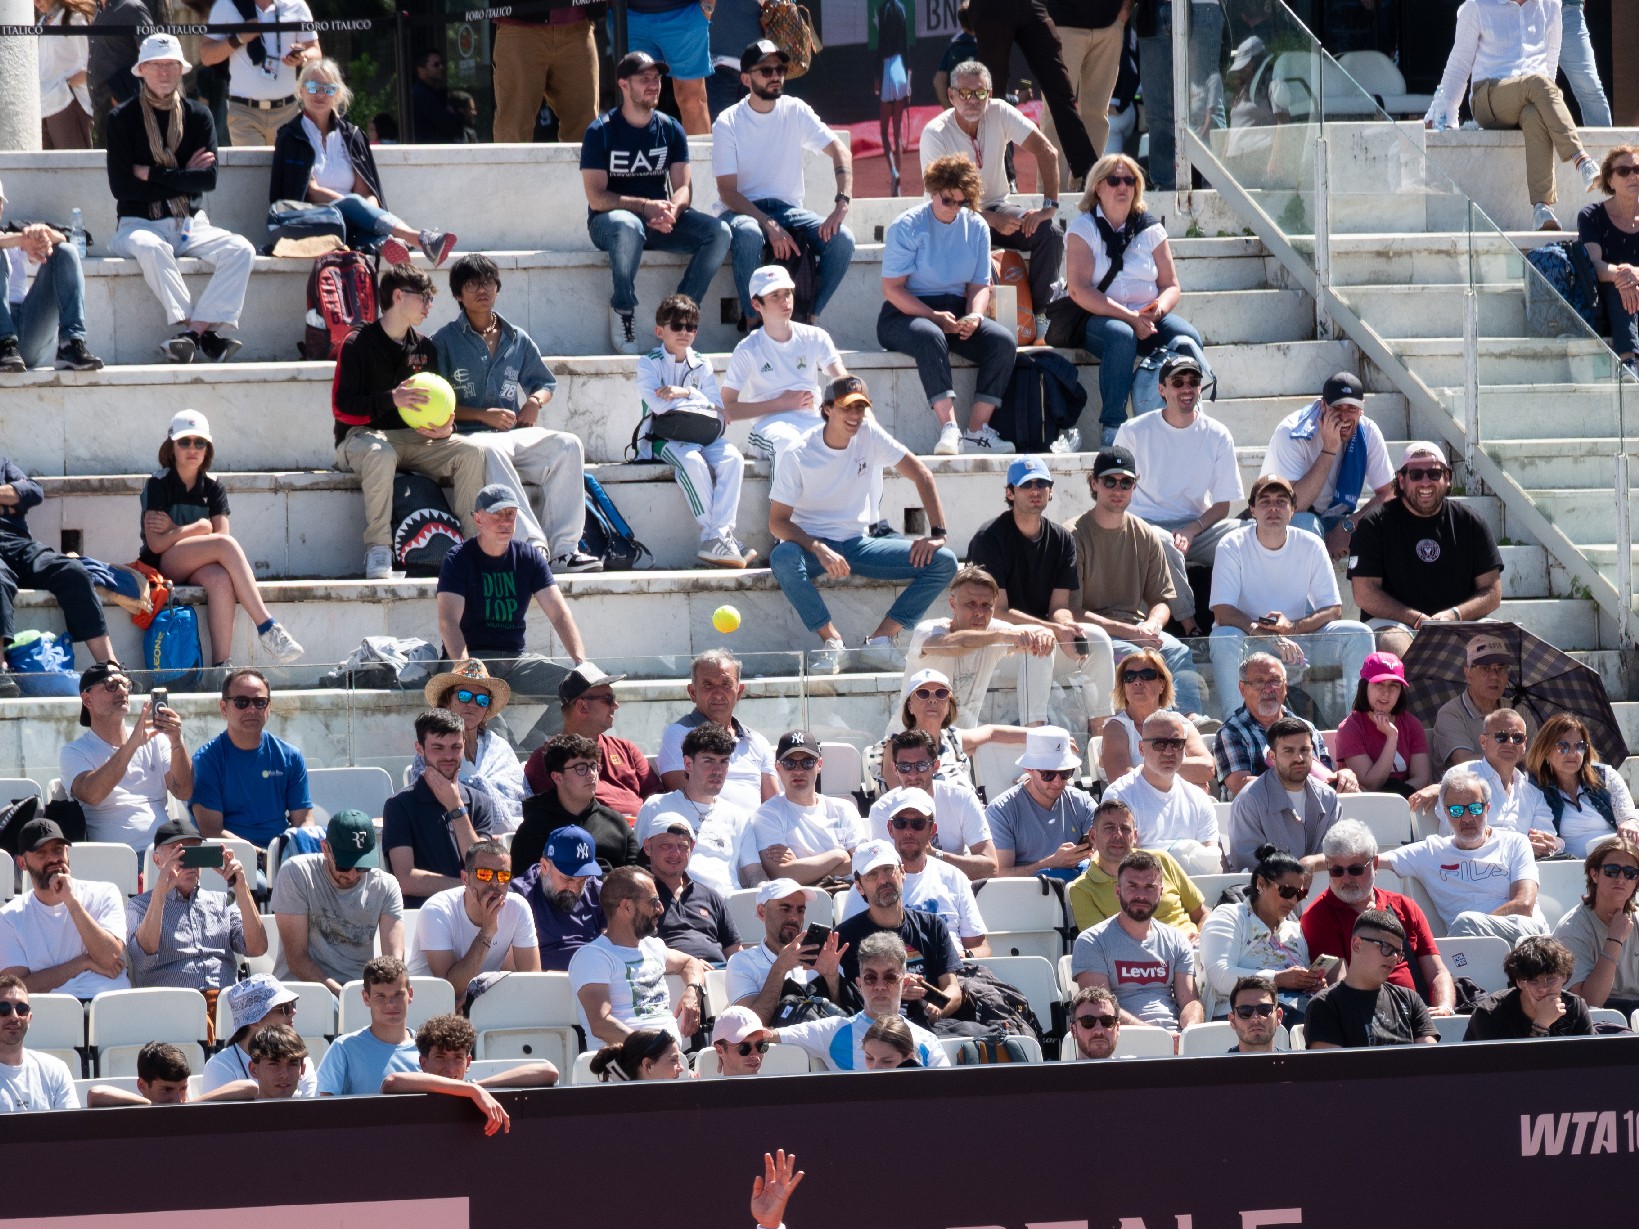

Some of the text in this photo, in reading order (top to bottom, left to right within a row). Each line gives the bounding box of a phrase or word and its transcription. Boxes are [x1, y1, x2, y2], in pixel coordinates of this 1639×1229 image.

[465, 5, 512, 22] FORO ITALICO
[2, 25, 44, 35] ITALICO
[136, 24, 208, 35] FORO ITALICO
[301, 19, 372, 32] FORO ITALICO
[609, 146, 668, 173] EA7
[482, 571, 517, 598] DUN
[485, 599, 518, 621] LOP
[791, 731, 805, 744] NY
[576, 842, 589, 860] NY
[1439, 860, 1509, 882] FILA
[1520, 1110, 1639, 1157] WTA 1
